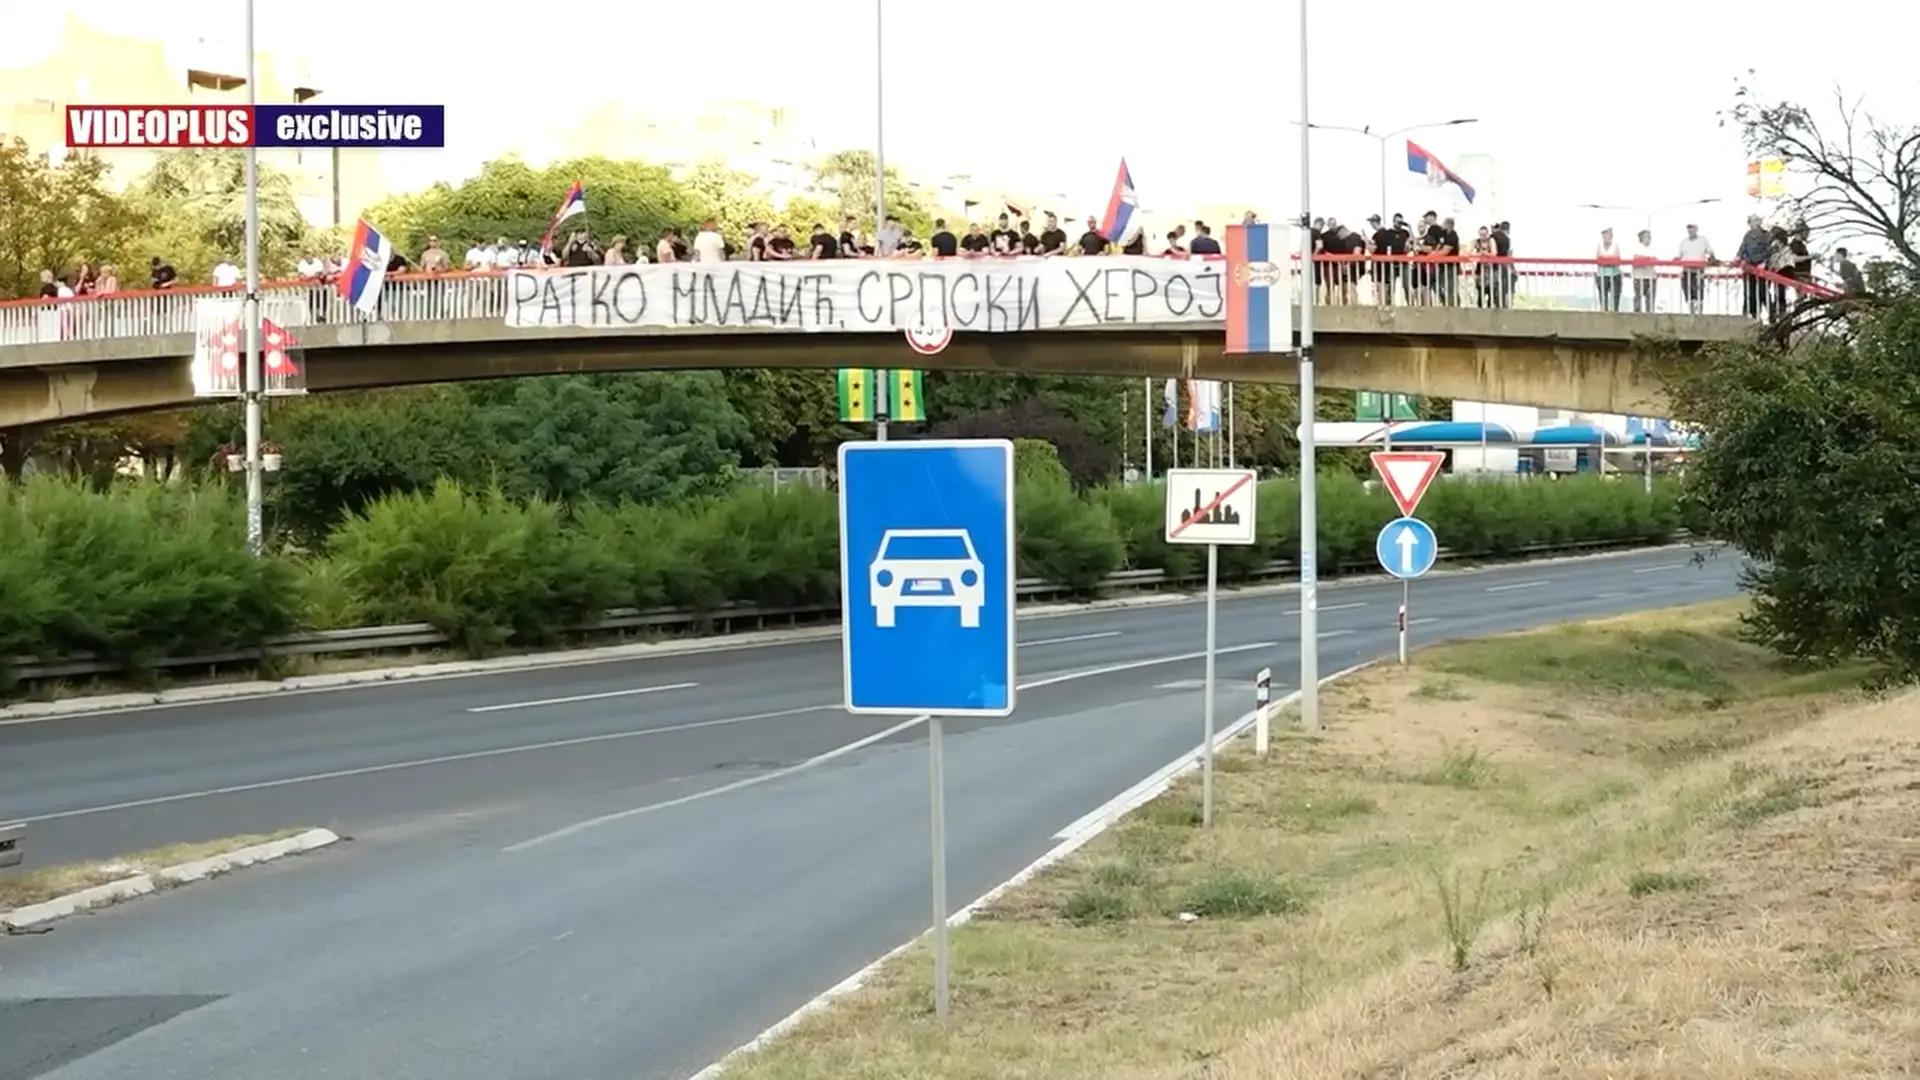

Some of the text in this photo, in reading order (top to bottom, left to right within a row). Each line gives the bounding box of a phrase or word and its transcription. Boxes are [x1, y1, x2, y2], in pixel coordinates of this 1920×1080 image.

[514, 270, 647, 326] РАТКО
[857, 270, 1040, 331] СРПСКИ
[1059, 266, 1224, 326] ХЕРОЈ
